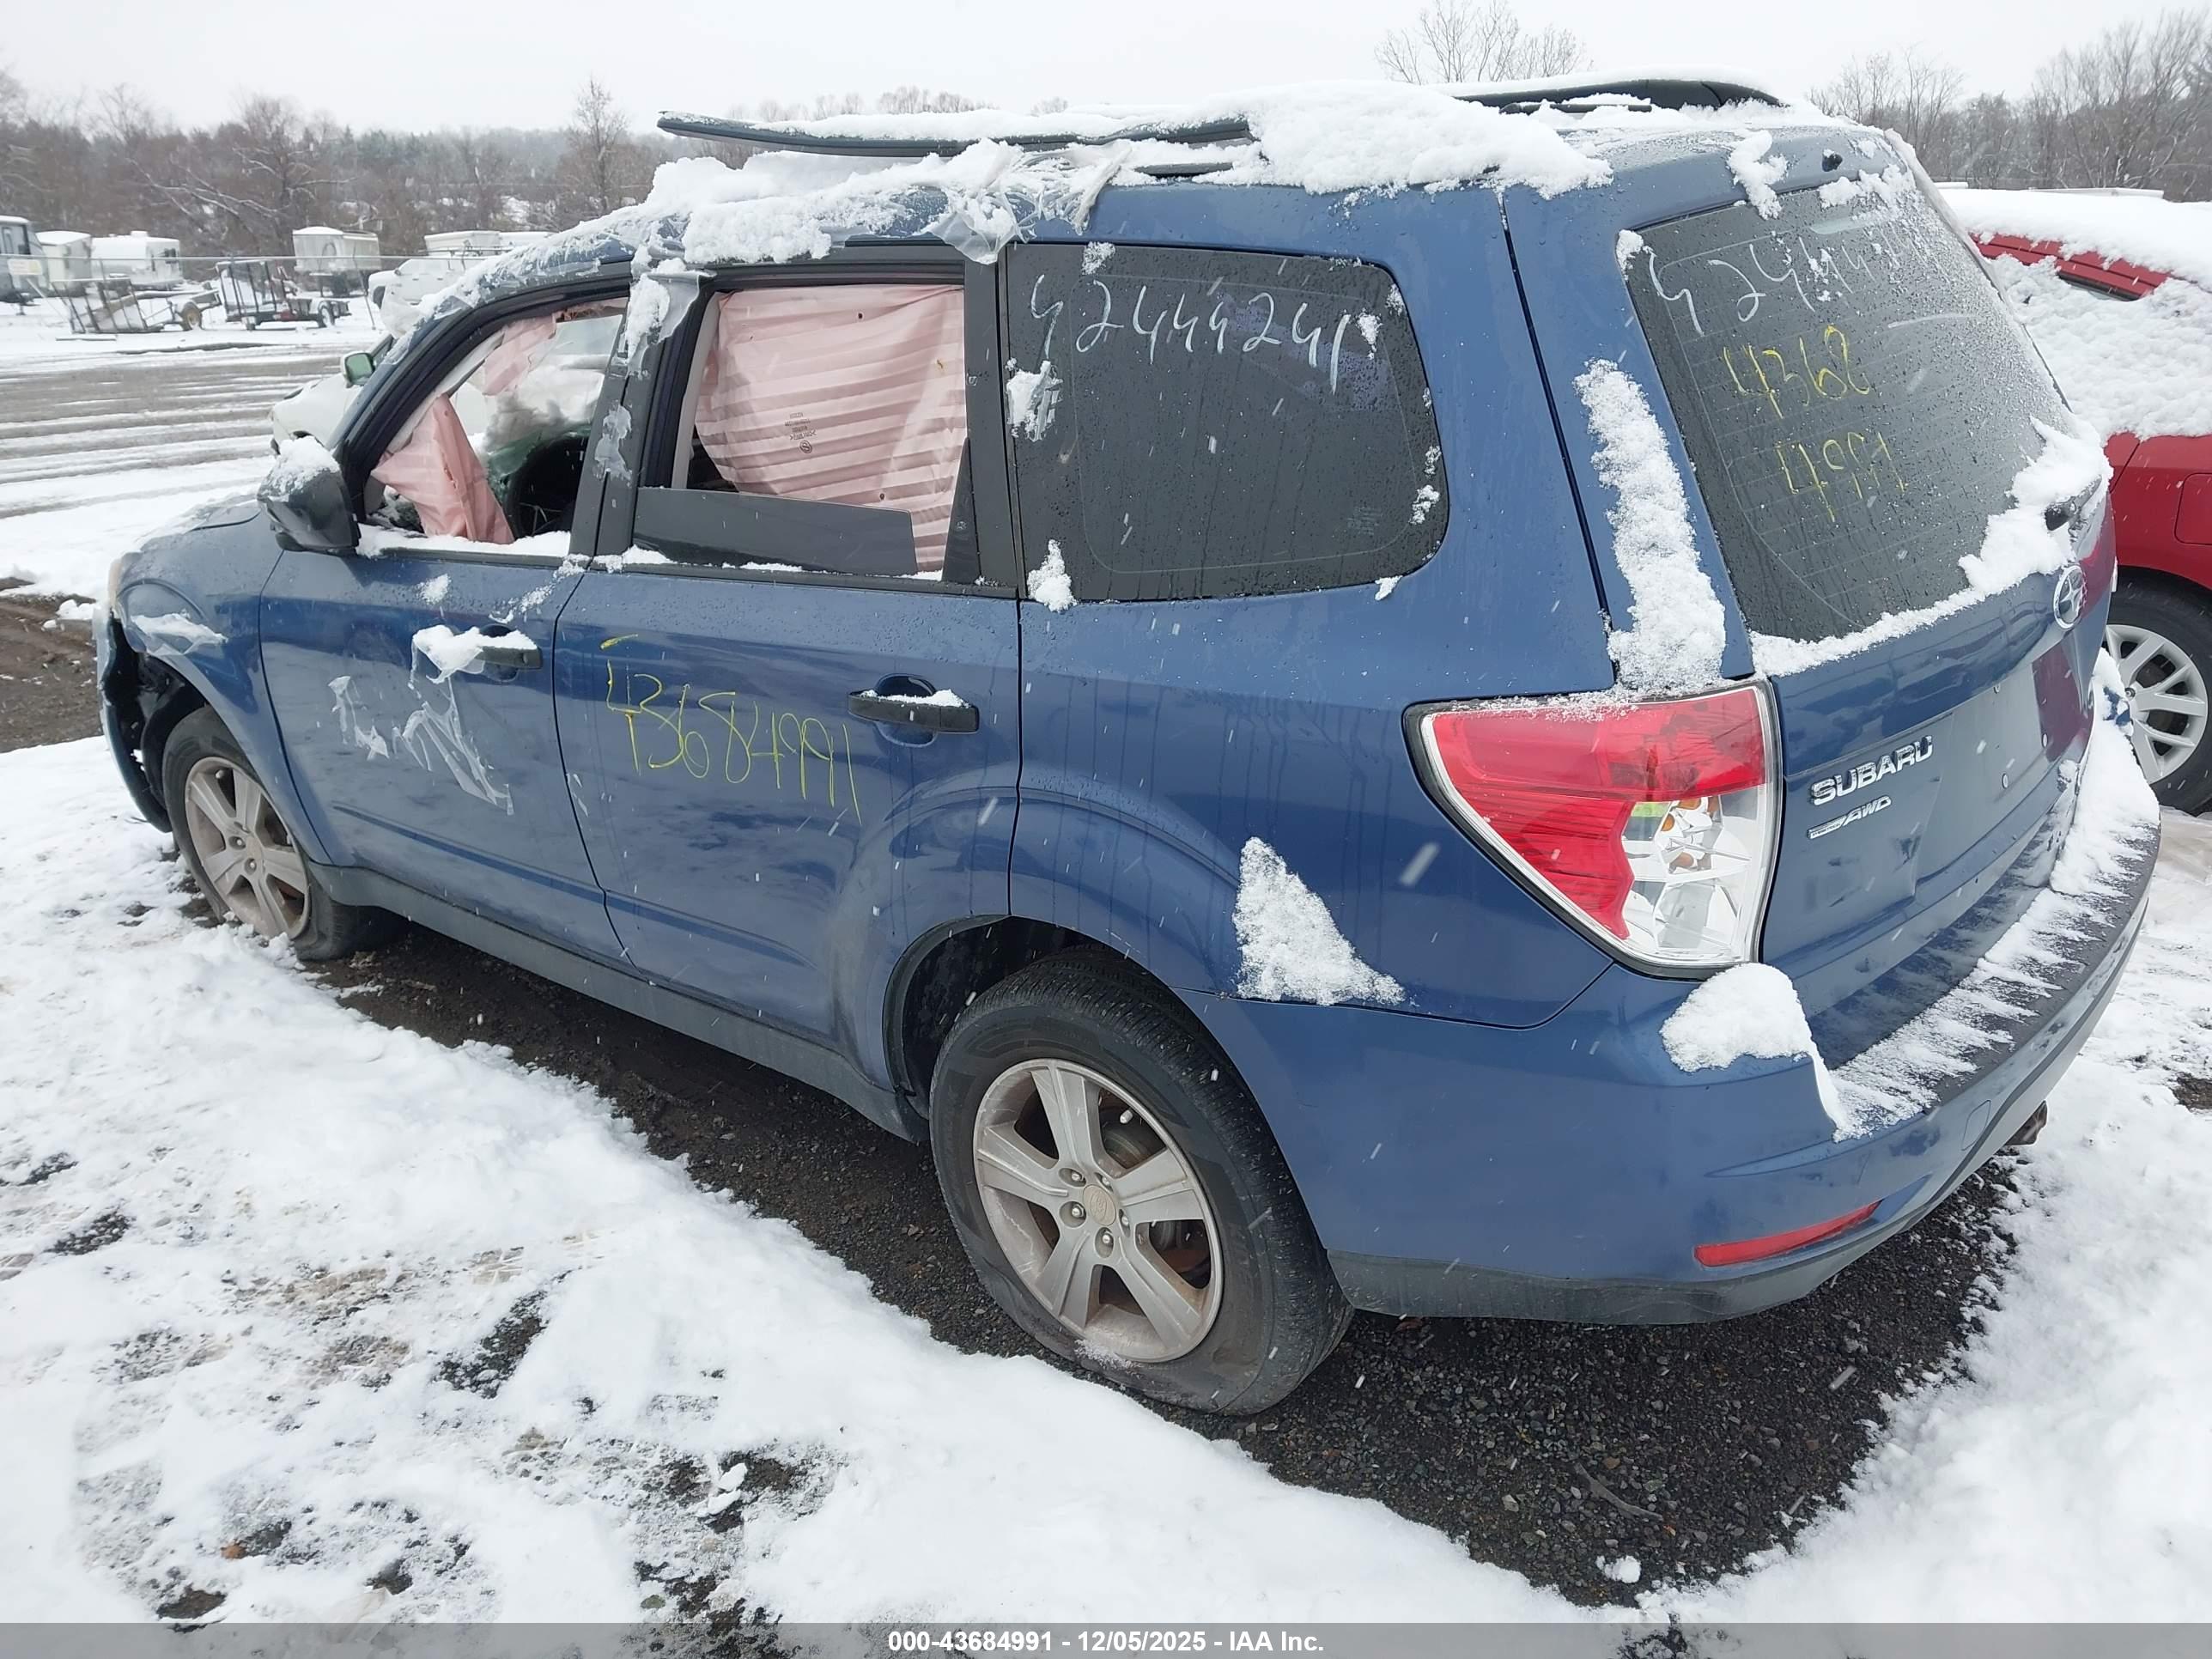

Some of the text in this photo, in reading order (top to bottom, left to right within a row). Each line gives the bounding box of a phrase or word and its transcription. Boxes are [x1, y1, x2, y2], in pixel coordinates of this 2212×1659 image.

[1030, 273, 1354, 395] 42444241
[605, 659, 862, 825] 43684991
[1810, 735, 1933, 806] SUBARU
[1843, 795, 1893, 827] AWD
